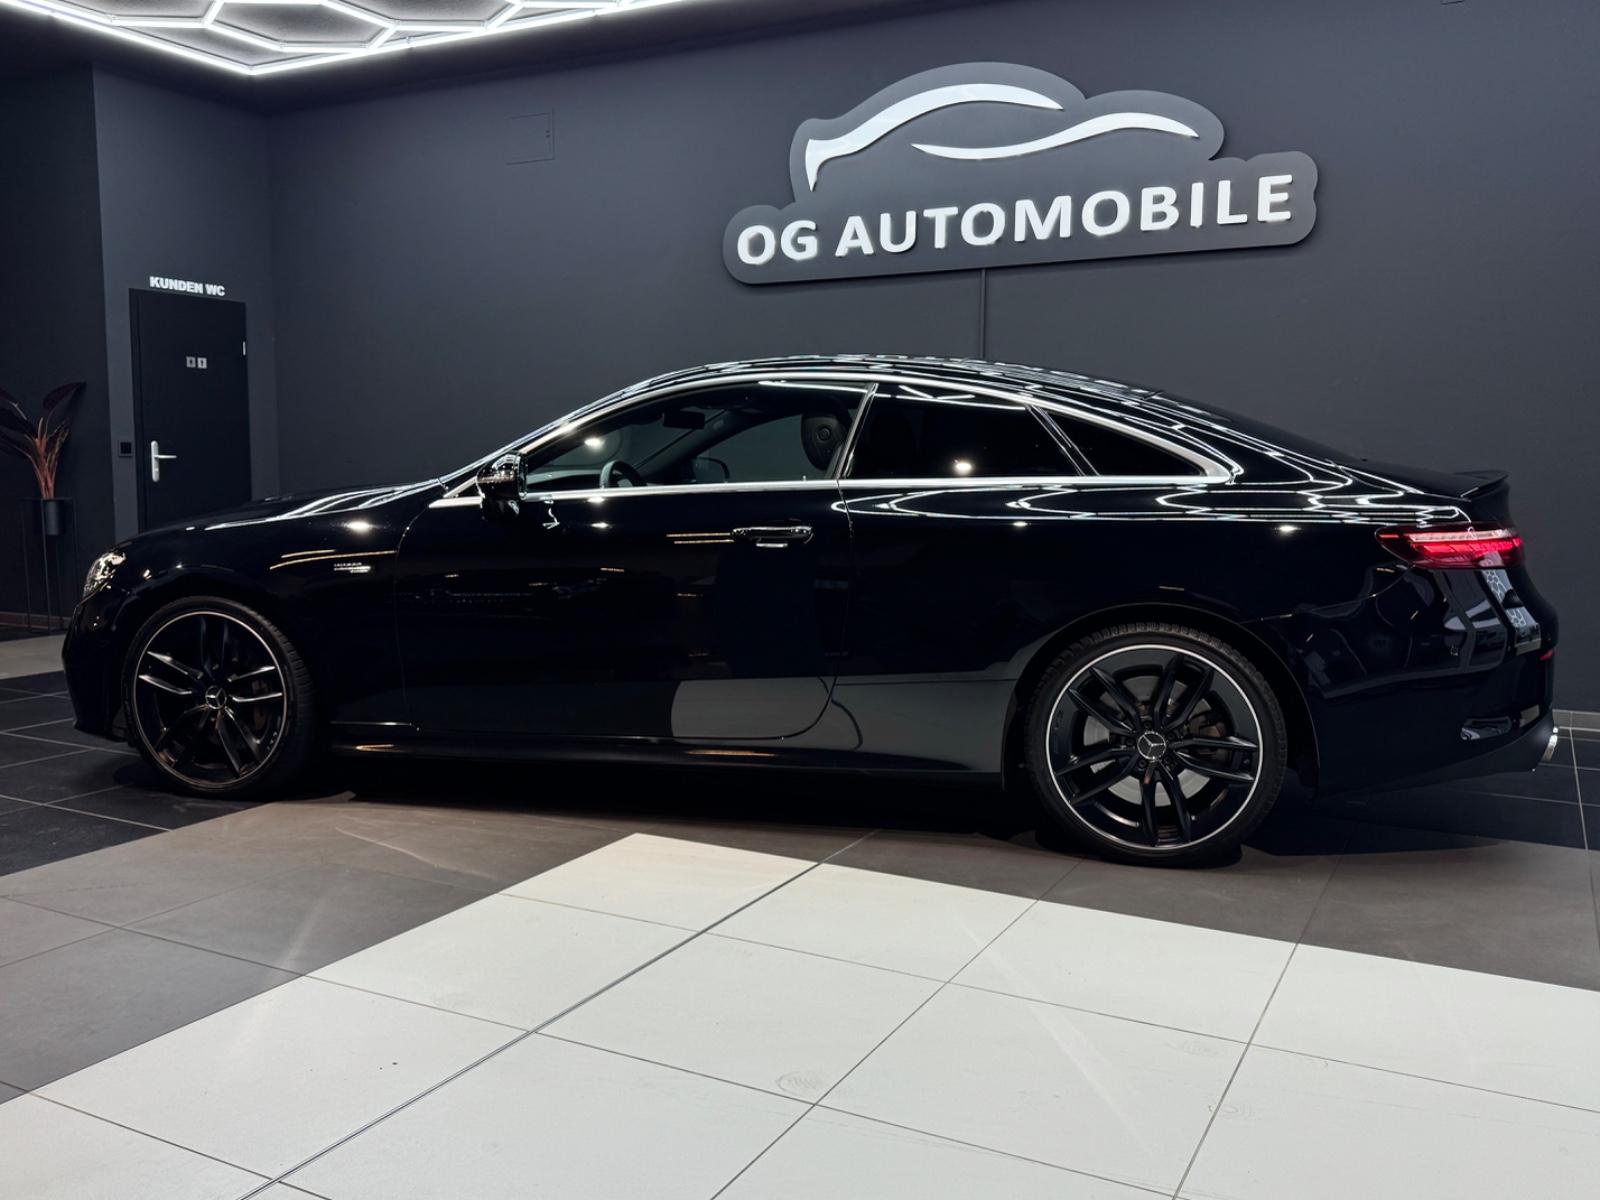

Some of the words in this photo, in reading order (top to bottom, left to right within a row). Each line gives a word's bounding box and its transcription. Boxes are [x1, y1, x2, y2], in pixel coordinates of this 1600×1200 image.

[736, 219, 820, 266] OG
[834, 173, 1294, 258] AUTOMOBILE
[149, 276, 204, 294] KUNDEN
[205, 283, 226, 297] WC
